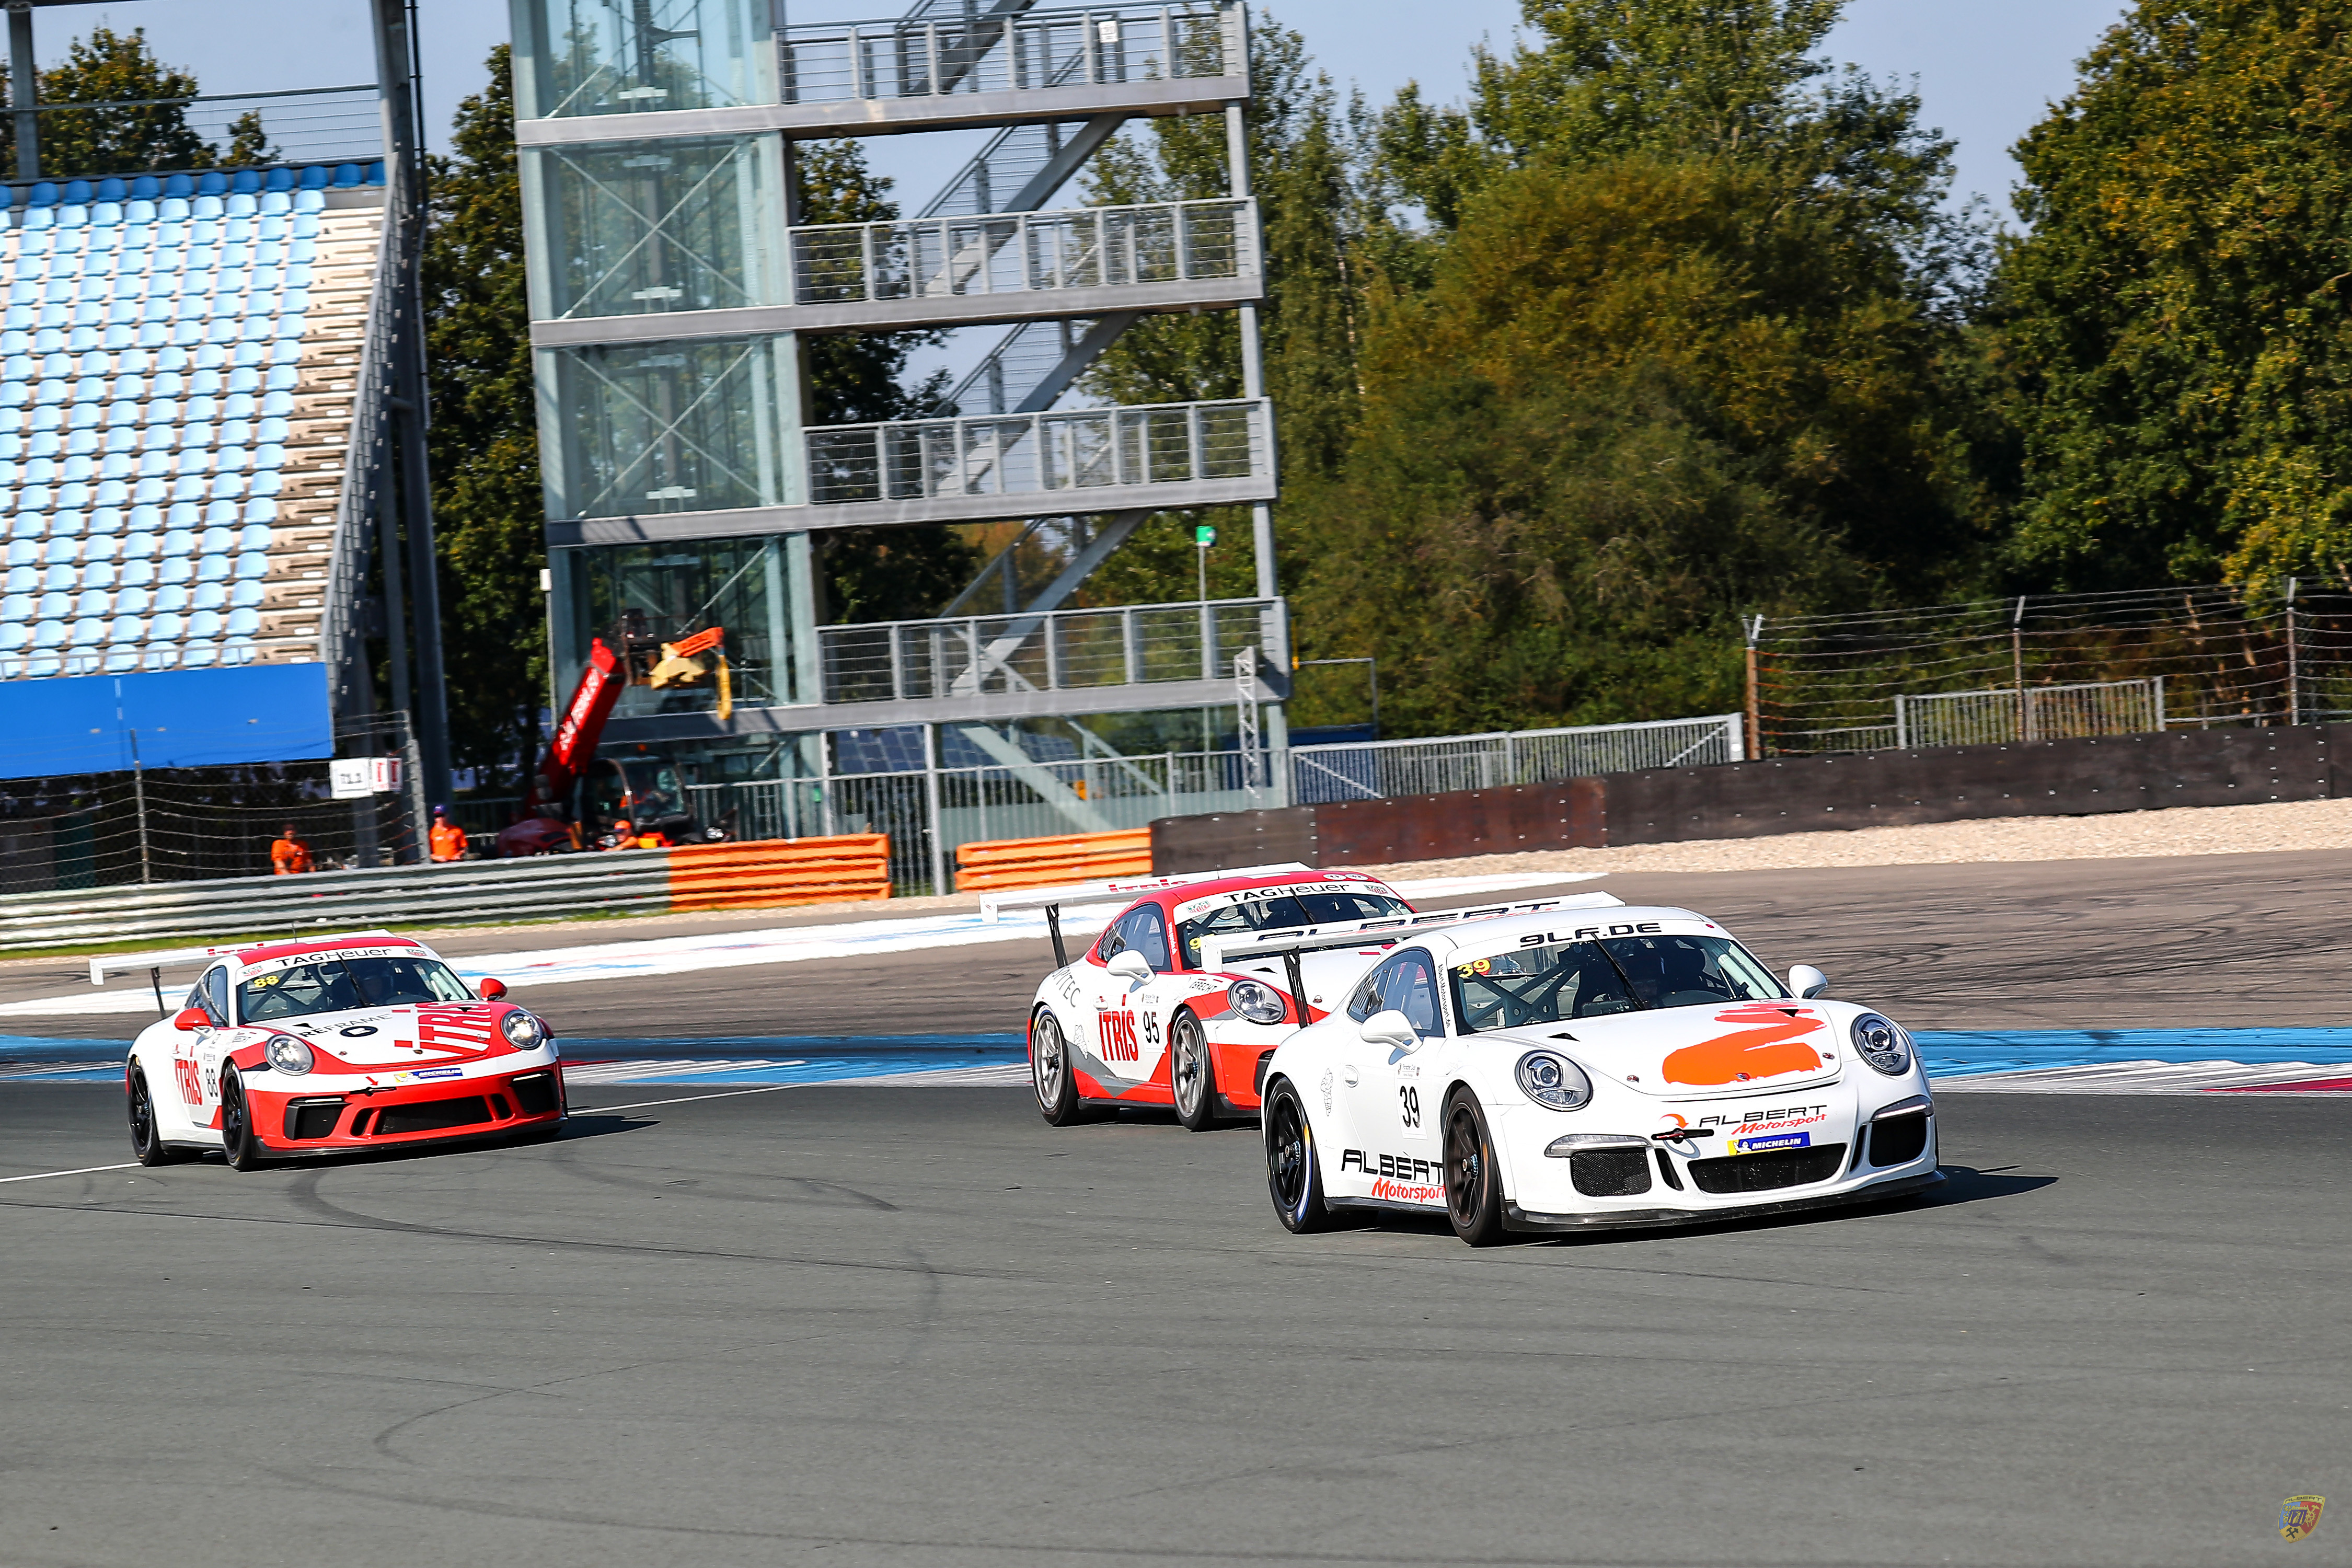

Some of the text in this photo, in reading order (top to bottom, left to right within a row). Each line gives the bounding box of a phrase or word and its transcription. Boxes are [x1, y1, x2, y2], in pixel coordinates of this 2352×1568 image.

[1189, 933, 1215, 950] 9
[1457, 959, 1491, 978] 39
[254, 975, 279, 988] 88
[299, 1013, 393, 1037] REFRAME
[1143, 1010, 1159, 1044] 95
[206, 1068, 218, 1097] 88
[1400, 1086, 1420, 1128] 39
[1699, 1105, 1827, 1127] ALBERT
[1731, 1114, 1827, 1135] Motorsport
[1751, 1138, 1802, 1149] MICHELIN
[1341, 1149, 1444, 1184] ALBERT
[1371, 1177, 1446, 1203] Motorsport
